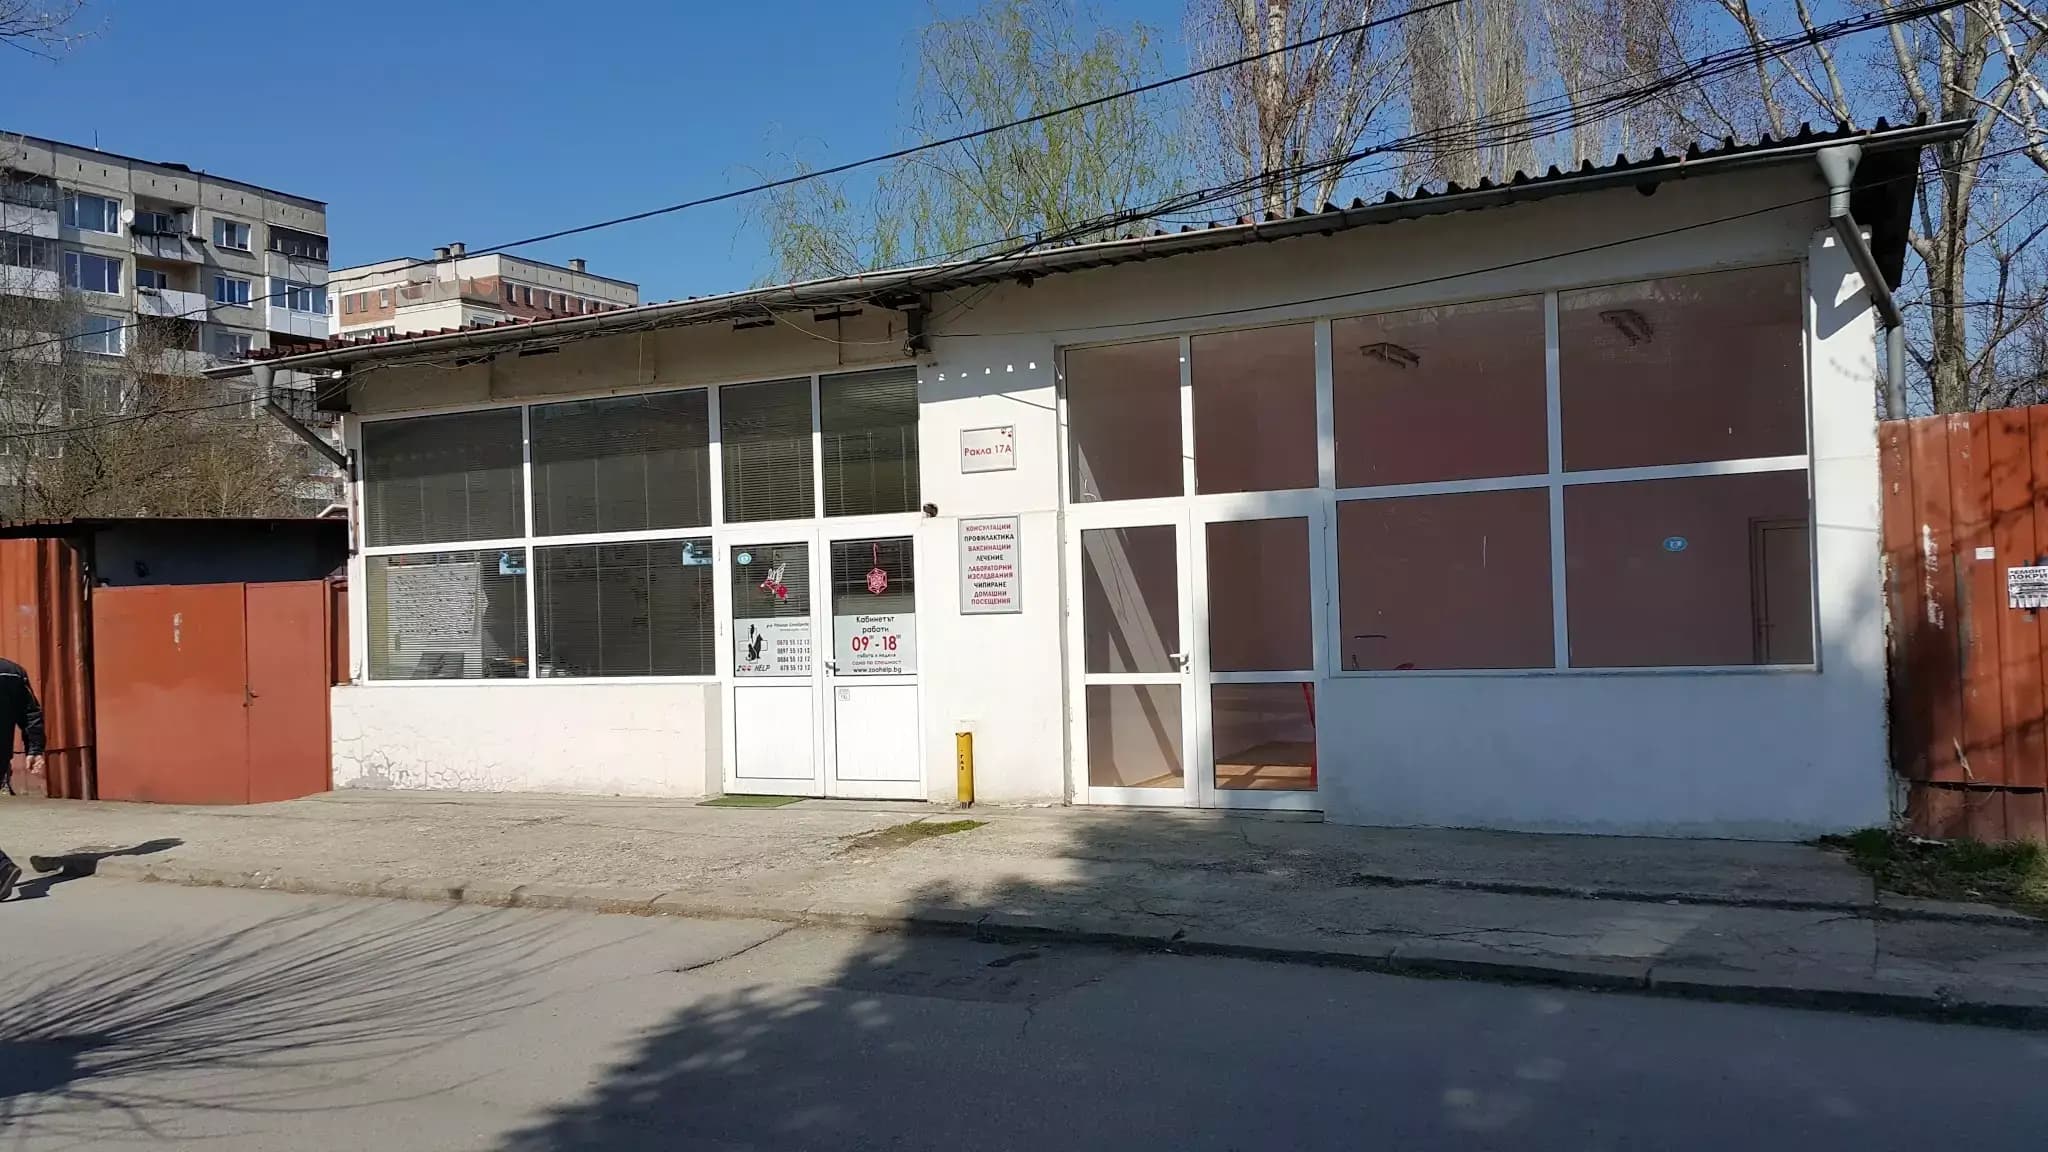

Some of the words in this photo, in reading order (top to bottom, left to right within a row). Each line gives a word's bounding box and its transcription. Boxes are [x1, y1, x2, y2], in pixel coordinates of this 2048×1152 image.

[964, 447, 992, 456] Ракла
[994, 444, 1012, 453] 17А
[966, 523, 1011, 531] КОНСУЛТАЦИИ
[964, 533, 1014, 542] ПРОФИЛАКТИКА
[967, 544, 1011, 552] ВАКСИНАЦИИ
[968, 564, 1012, 572] ЛАБОРАТОРНИ
[967, 572, 1013, 580] ИЗСЛЕДВАНИЯ
[856, 615, 895, 623] Кабинетът
[862, 625, 889, 634] работи
